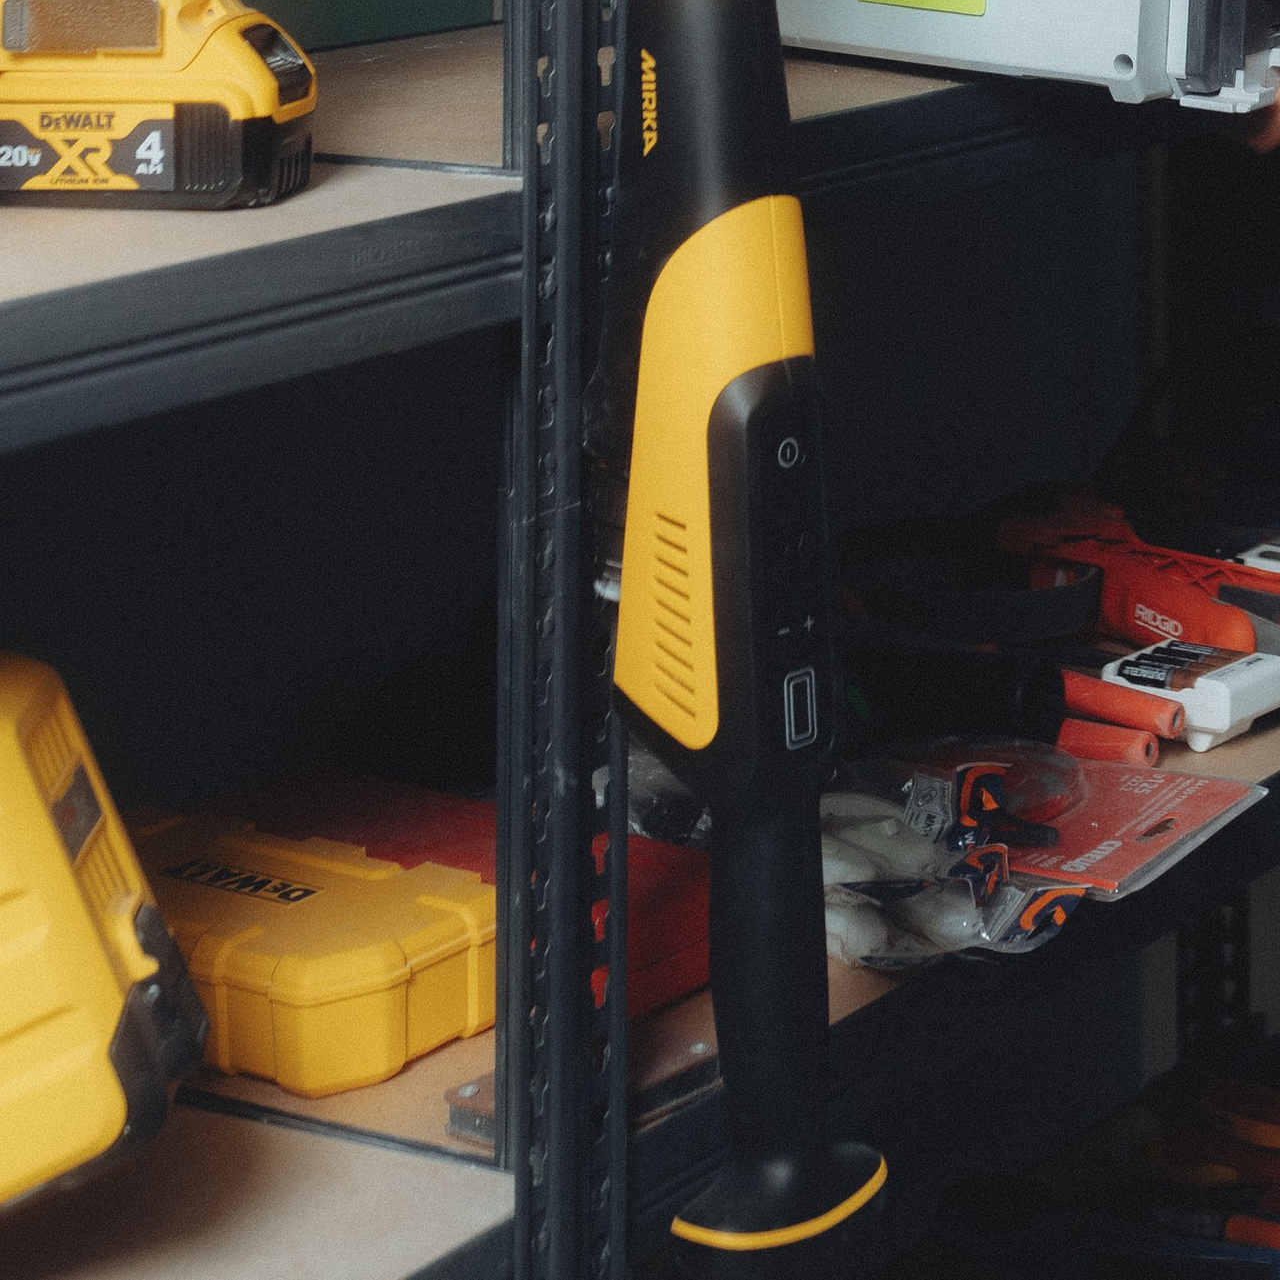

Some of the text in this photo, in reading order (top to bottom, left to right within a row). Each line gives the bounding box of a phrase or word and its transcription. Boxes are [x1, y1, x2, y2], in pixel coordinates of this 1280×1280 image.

[641, 48, 658, 157] MIRKA
[1134, 604, 1184, 637] RIDGID
[161, 860, 318, 903] DEWALT
